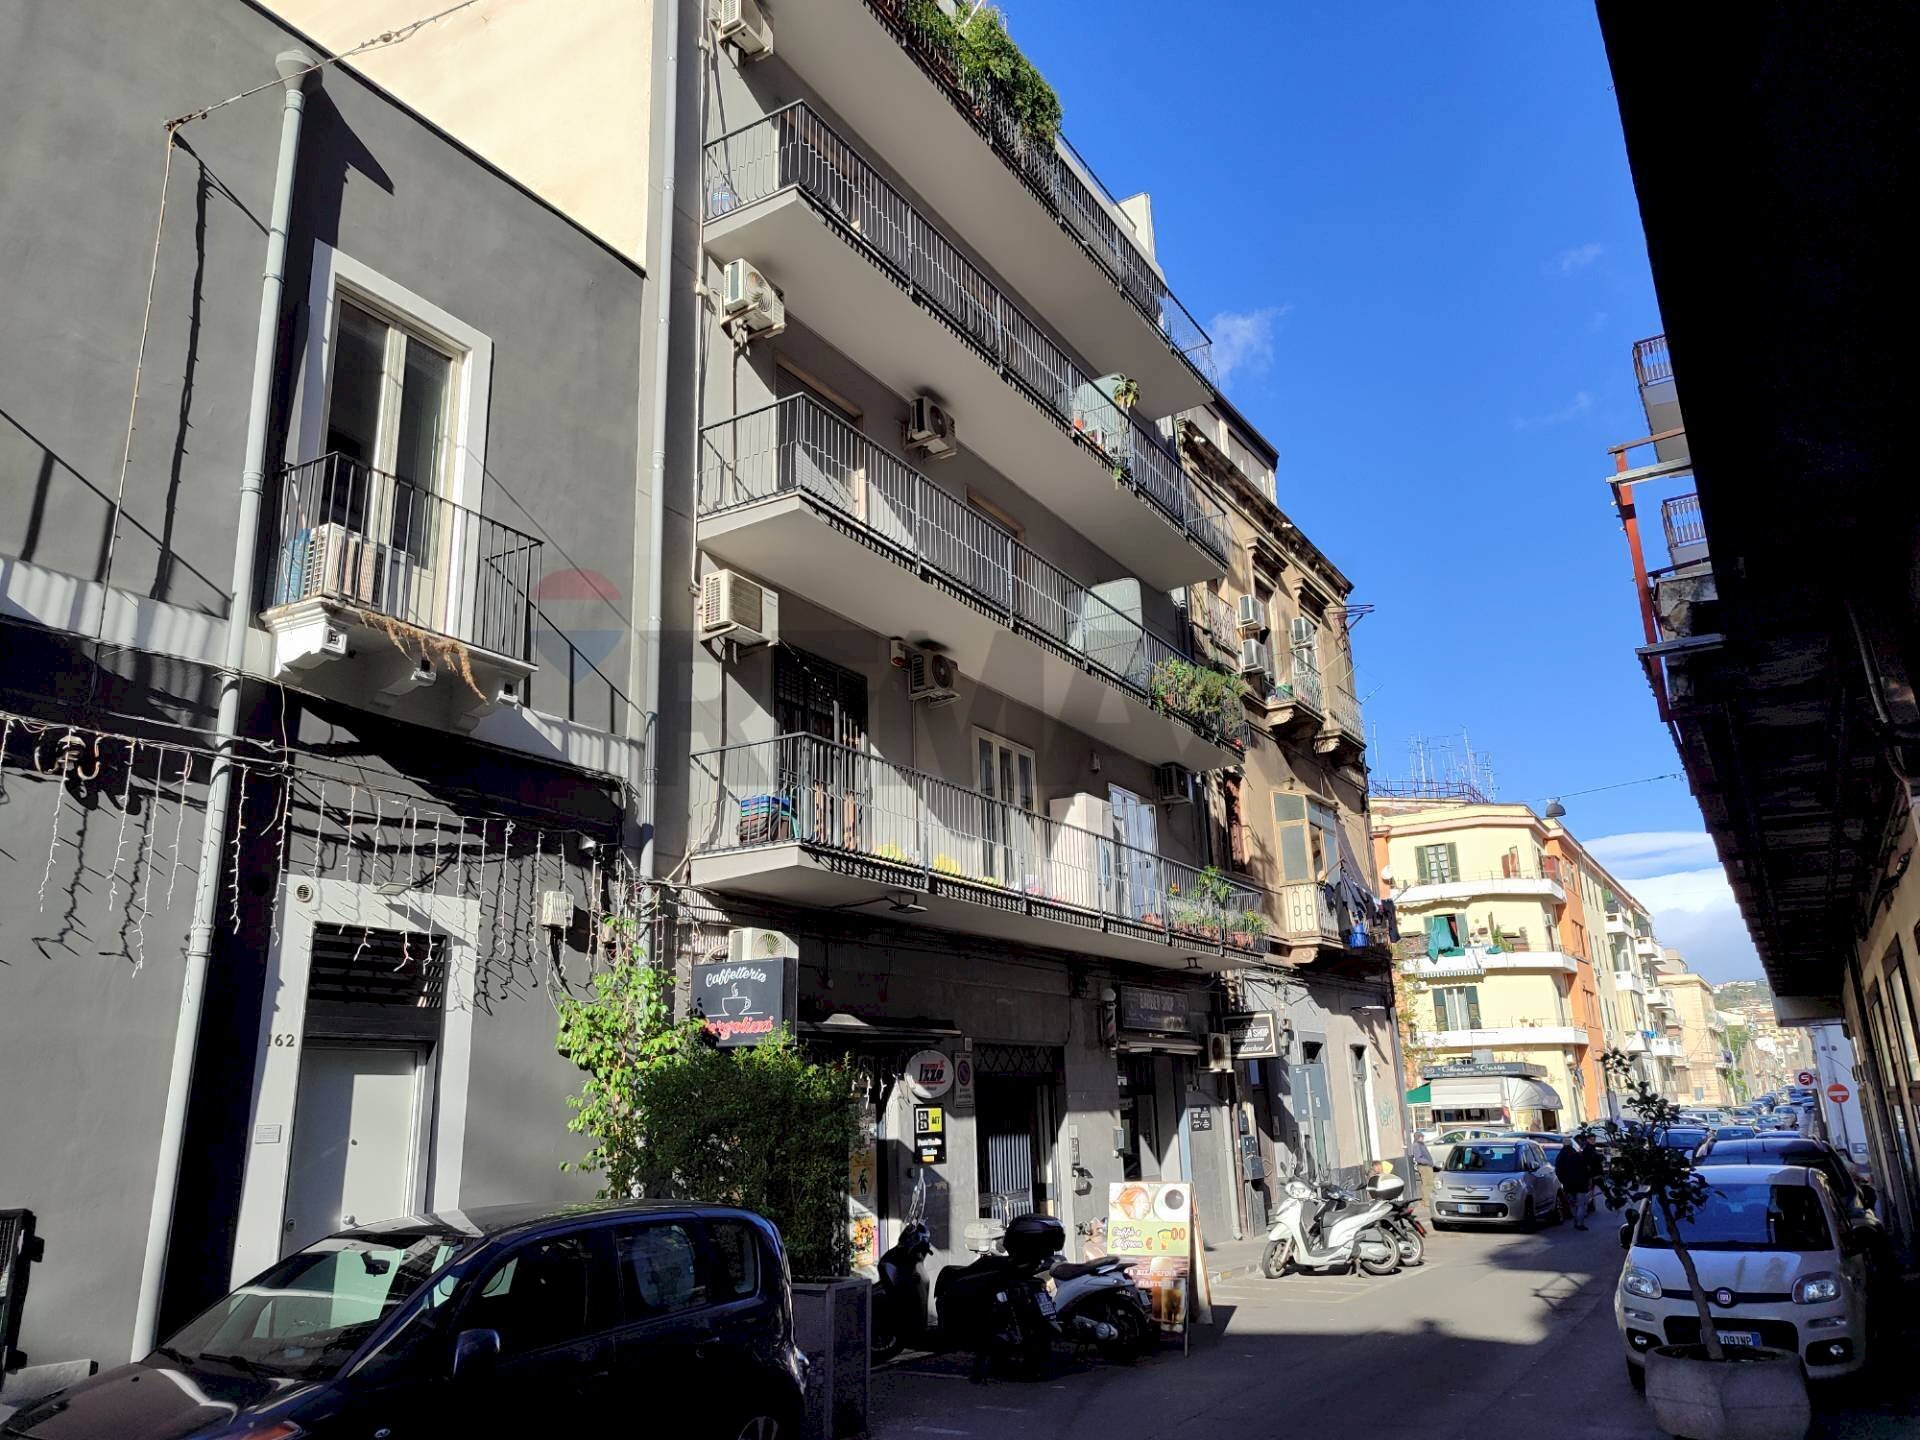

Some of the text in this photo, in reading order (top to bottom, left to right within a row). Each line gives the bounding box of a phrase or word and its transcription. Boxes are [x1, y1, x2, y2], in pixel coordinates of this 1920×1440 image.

[705, 966, 767, 988] Caffetteria
[1253, 1028, 1269, 1037] SHOP
[266, 1033, 295, 1047] 162
